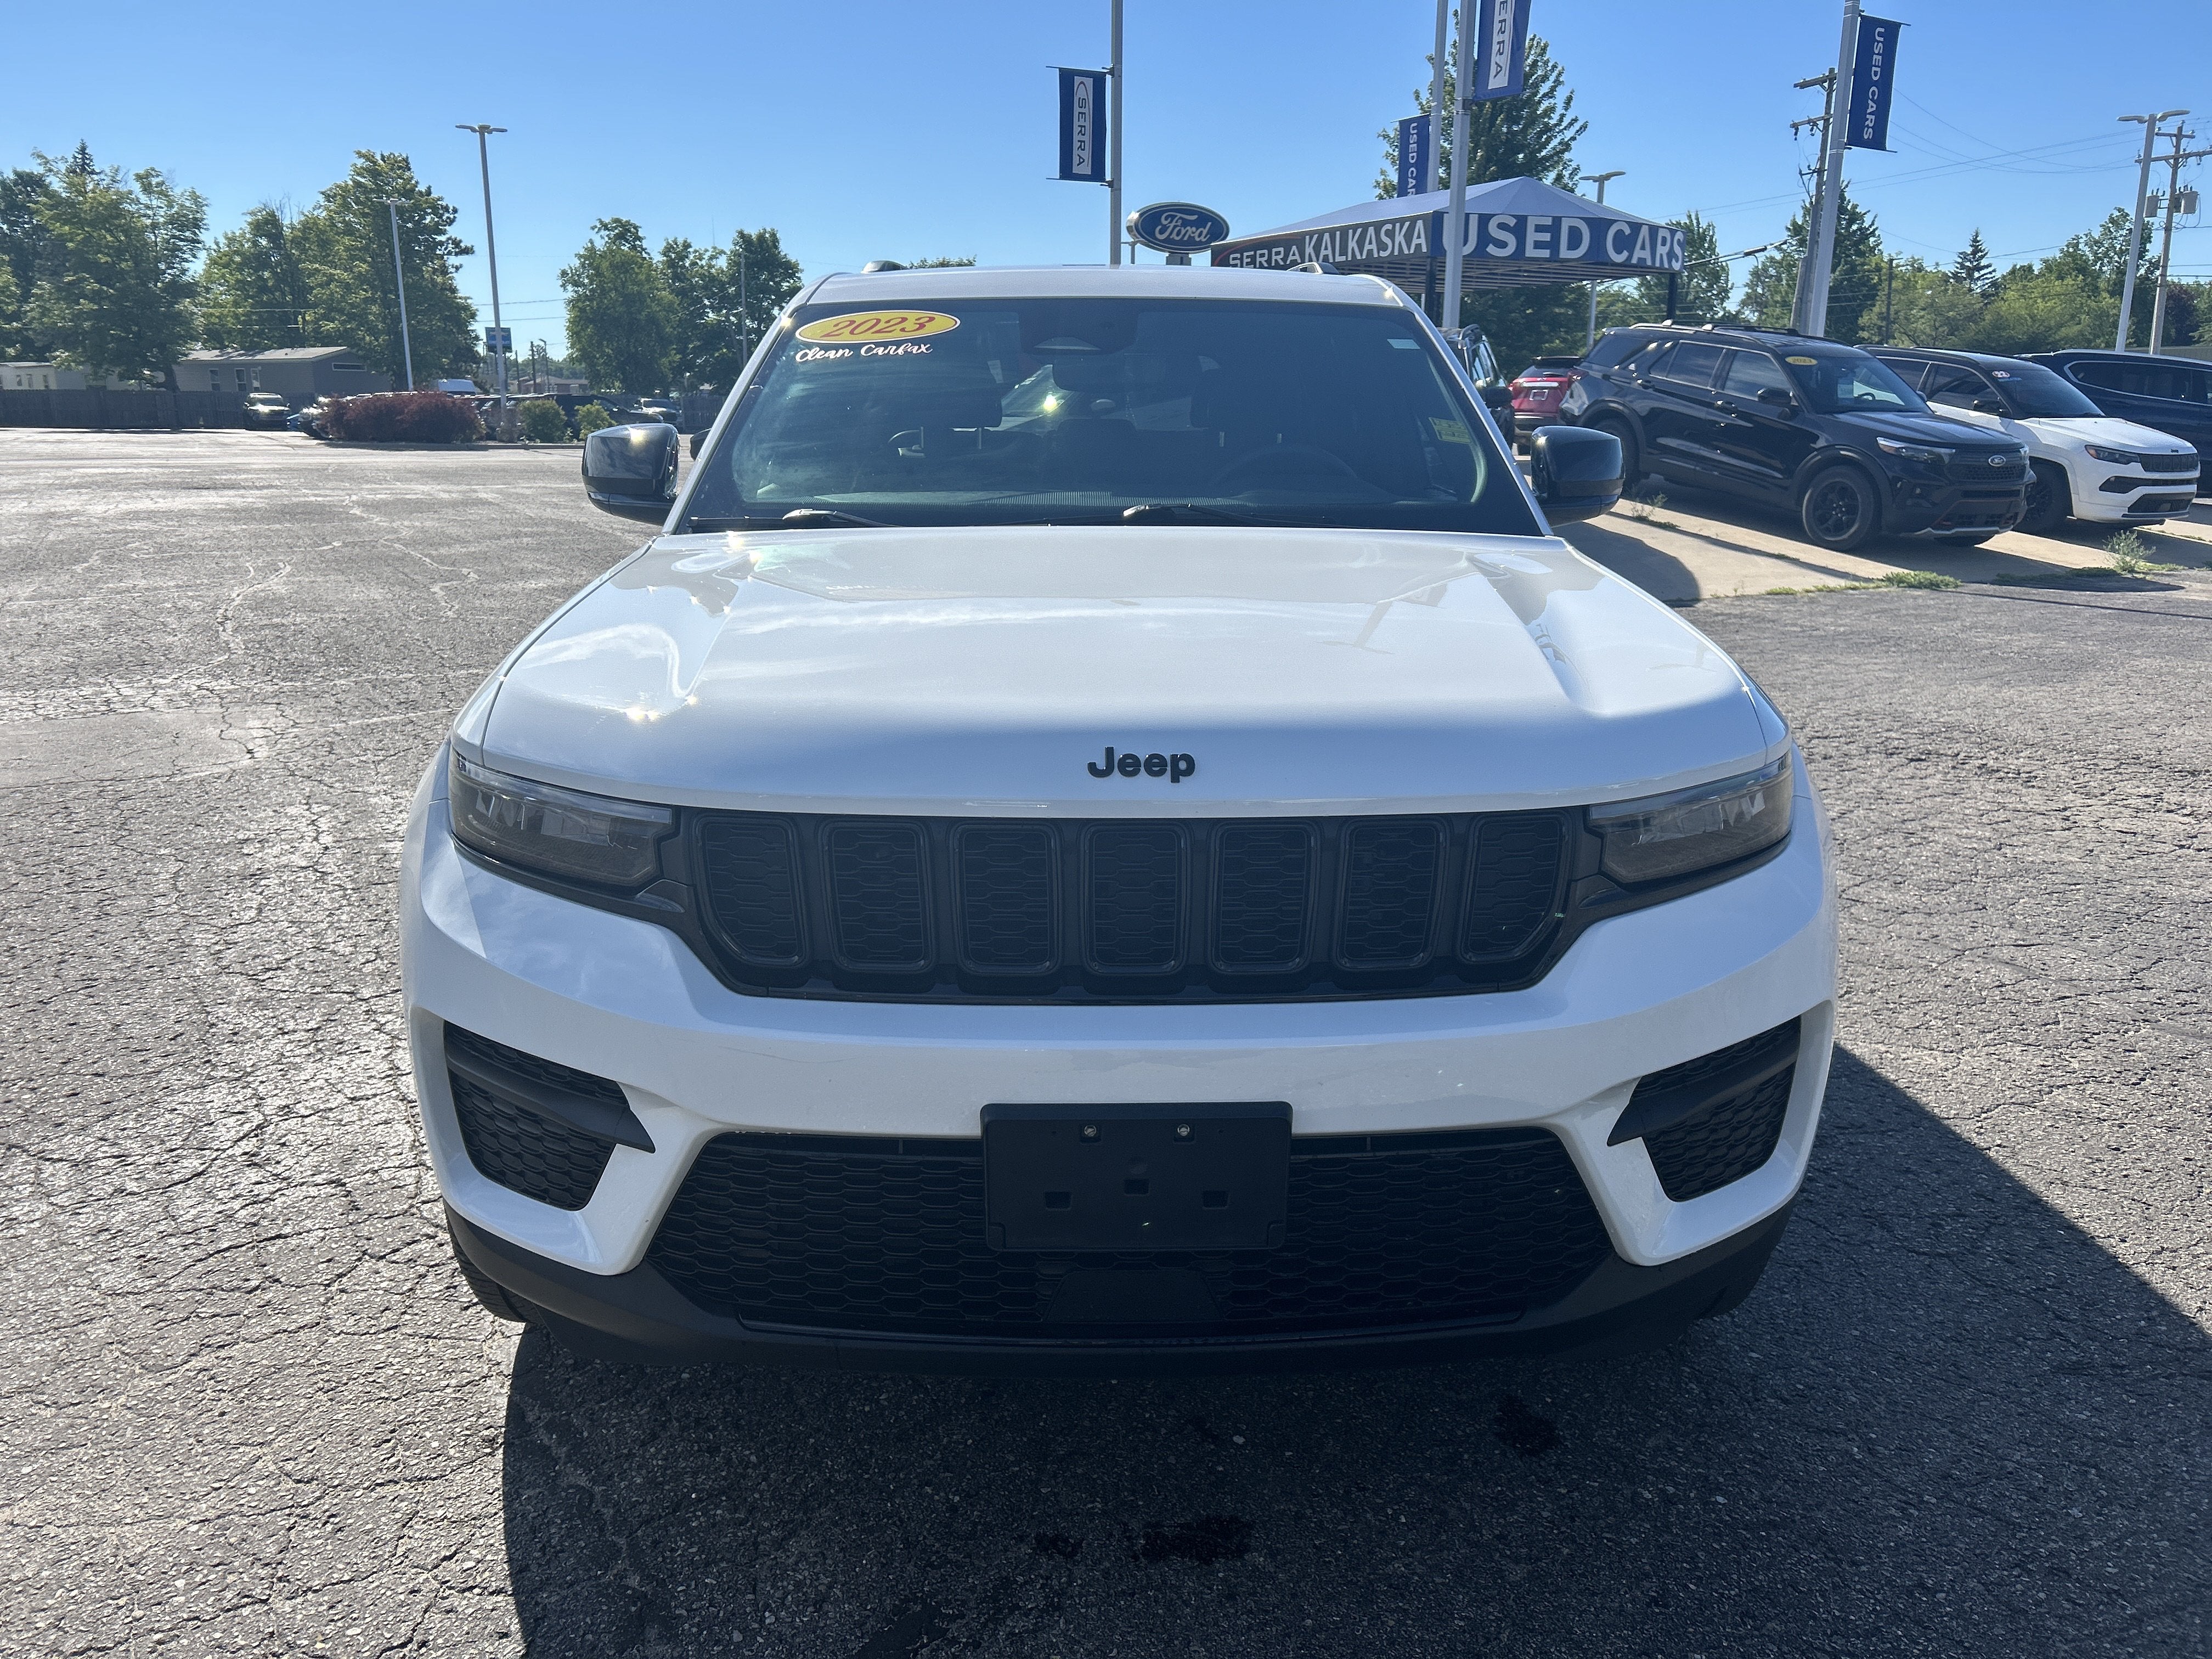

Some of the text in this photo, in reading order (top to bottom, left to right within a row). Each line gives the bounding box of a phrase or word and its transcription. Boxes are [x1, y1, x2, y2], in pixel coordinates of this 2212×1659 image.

[1493, 0, 1508, 80] ERRA
[1864, 27, 1885, 140] USED CARS
[1077, 97, 1086, 167] SERRA
[1407, 122, 1418, 196] USED CAR
[1155, 212, 1212, 242] Ford
[1229, 219, 1427, 268] SERRA KALKASKA
[1442, 214, 1685, 271] USED CARS
[795, 342, 933, 363] Clean Carfax
[820, 316, 936, 338] 2023
[1087, 746, 1196, 783] Jeep
